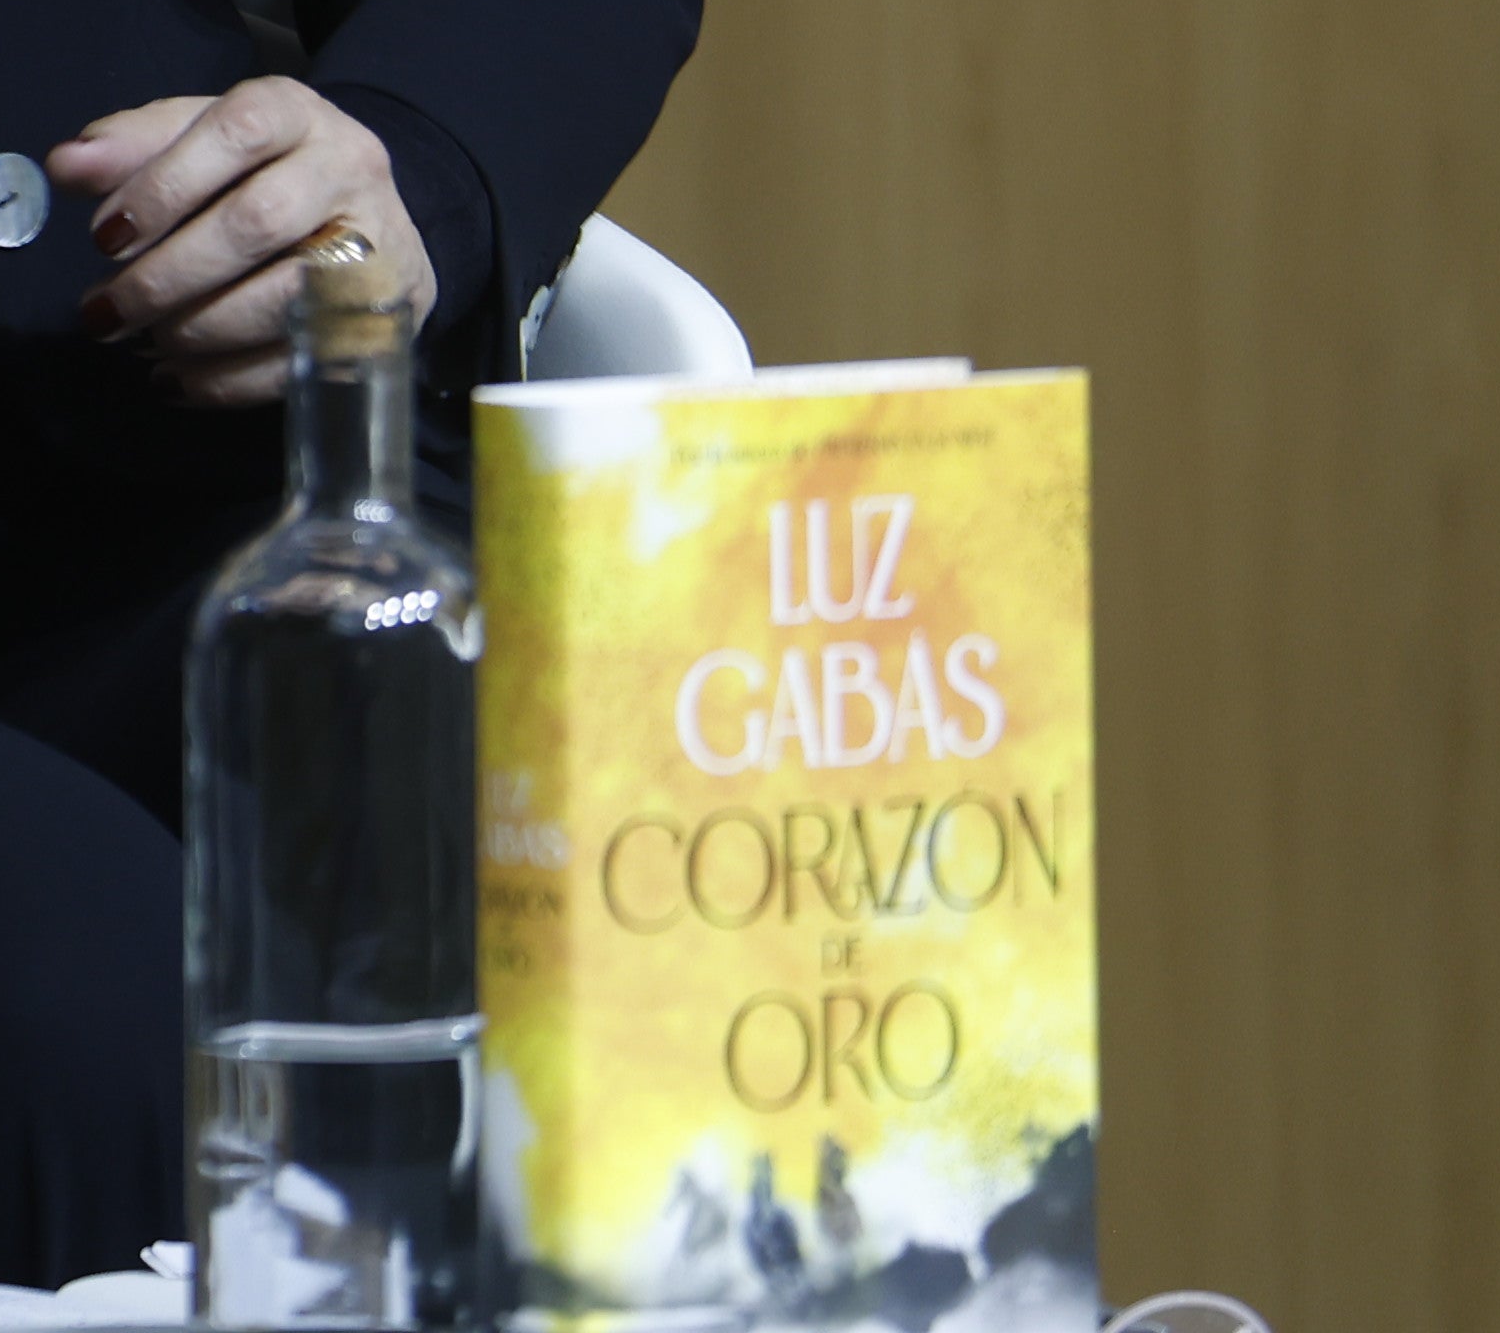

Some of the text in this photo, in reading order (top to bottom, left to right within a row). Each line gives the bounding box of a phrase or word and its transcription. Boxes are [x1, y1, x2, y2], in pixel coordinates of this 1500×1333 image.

[769, 495, 914, 625] LUZ
[820, 937, 863, 976] DE
[724, 979, 961, 1114] ORO
